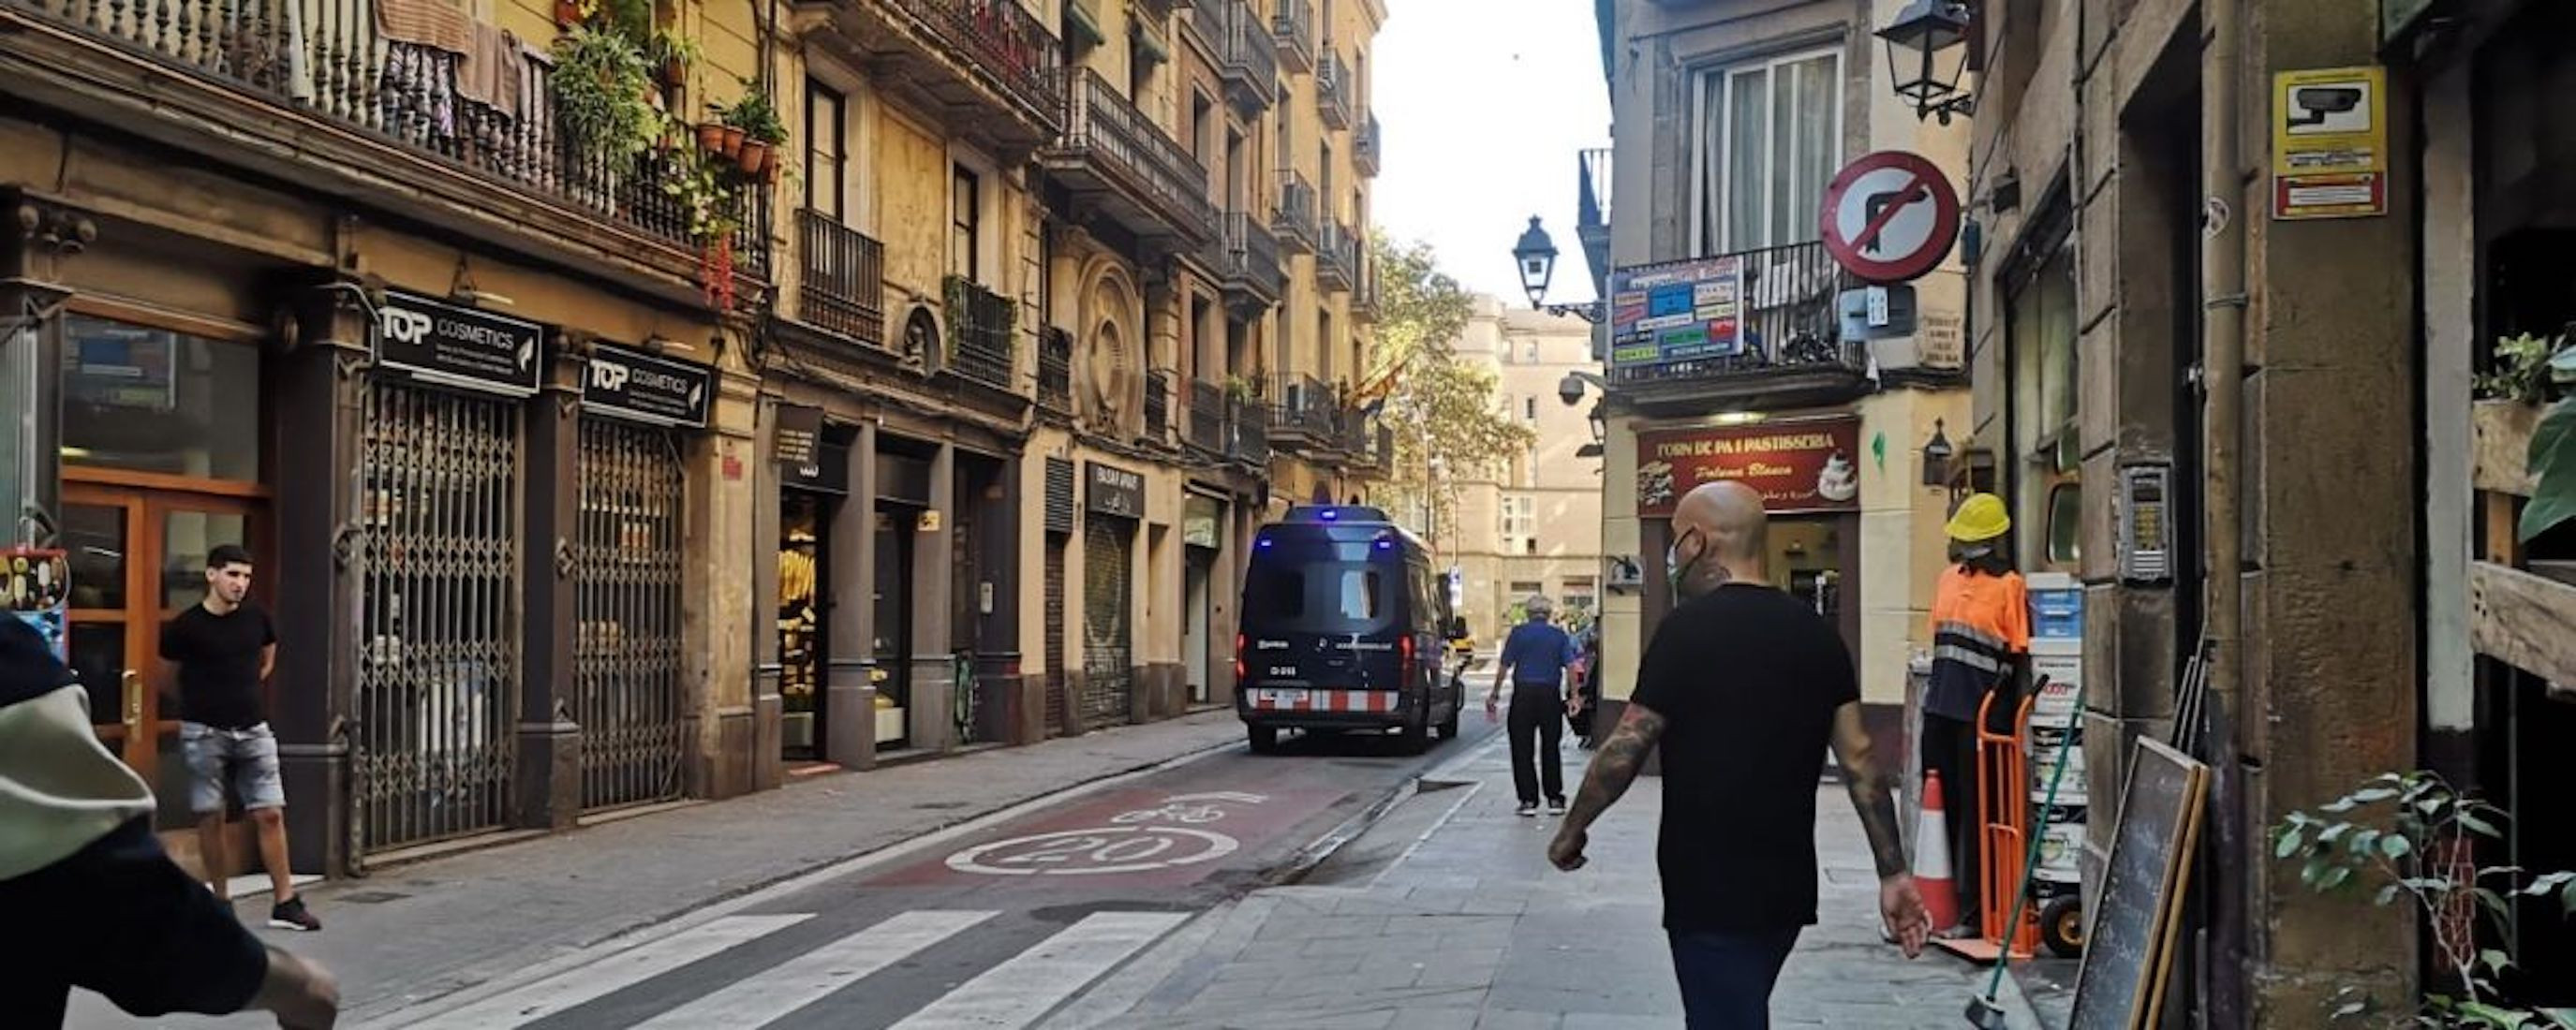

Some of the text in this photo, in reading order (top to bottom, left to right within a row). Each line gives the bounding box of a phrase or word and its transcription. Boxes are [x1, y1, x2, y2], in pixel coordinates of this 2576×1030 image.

[378, 305, 514, 351] TOP COSMETICS
[589, 359, 688, 394] TOP COSMETICS
[1715, 439, 1734, 454] PA
[1744, 434, 1834, 452] PASTISSERIA
[997, 836, 1172, 861] 20
